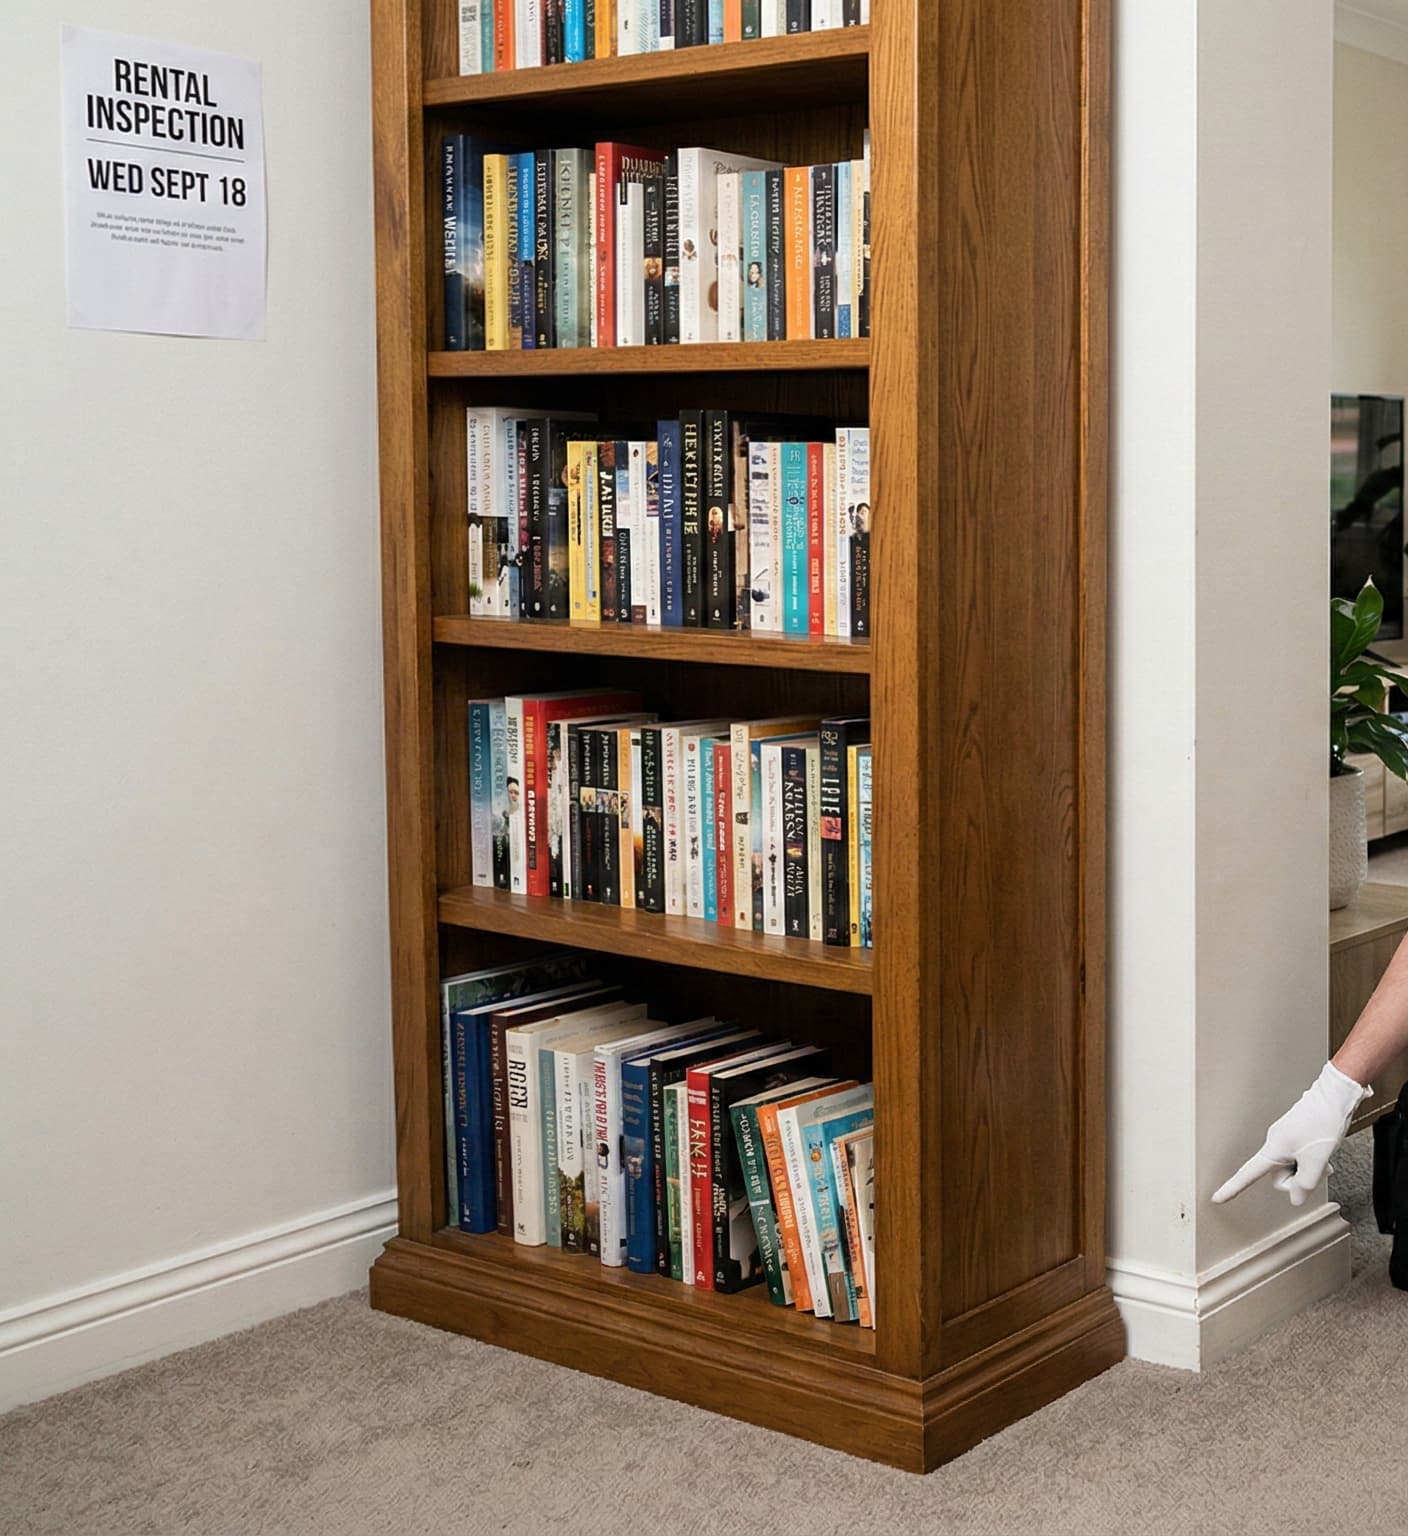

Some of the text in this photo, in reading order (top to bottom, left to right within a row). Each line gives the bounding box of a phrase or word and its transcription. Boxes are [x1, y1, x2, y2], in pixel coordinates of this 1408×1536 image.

[114, 58, 217, 107] RENTAL
[86, 94, 245, 150] INSPECTION
[87, 158, 246, 207] WED SEPT 18
